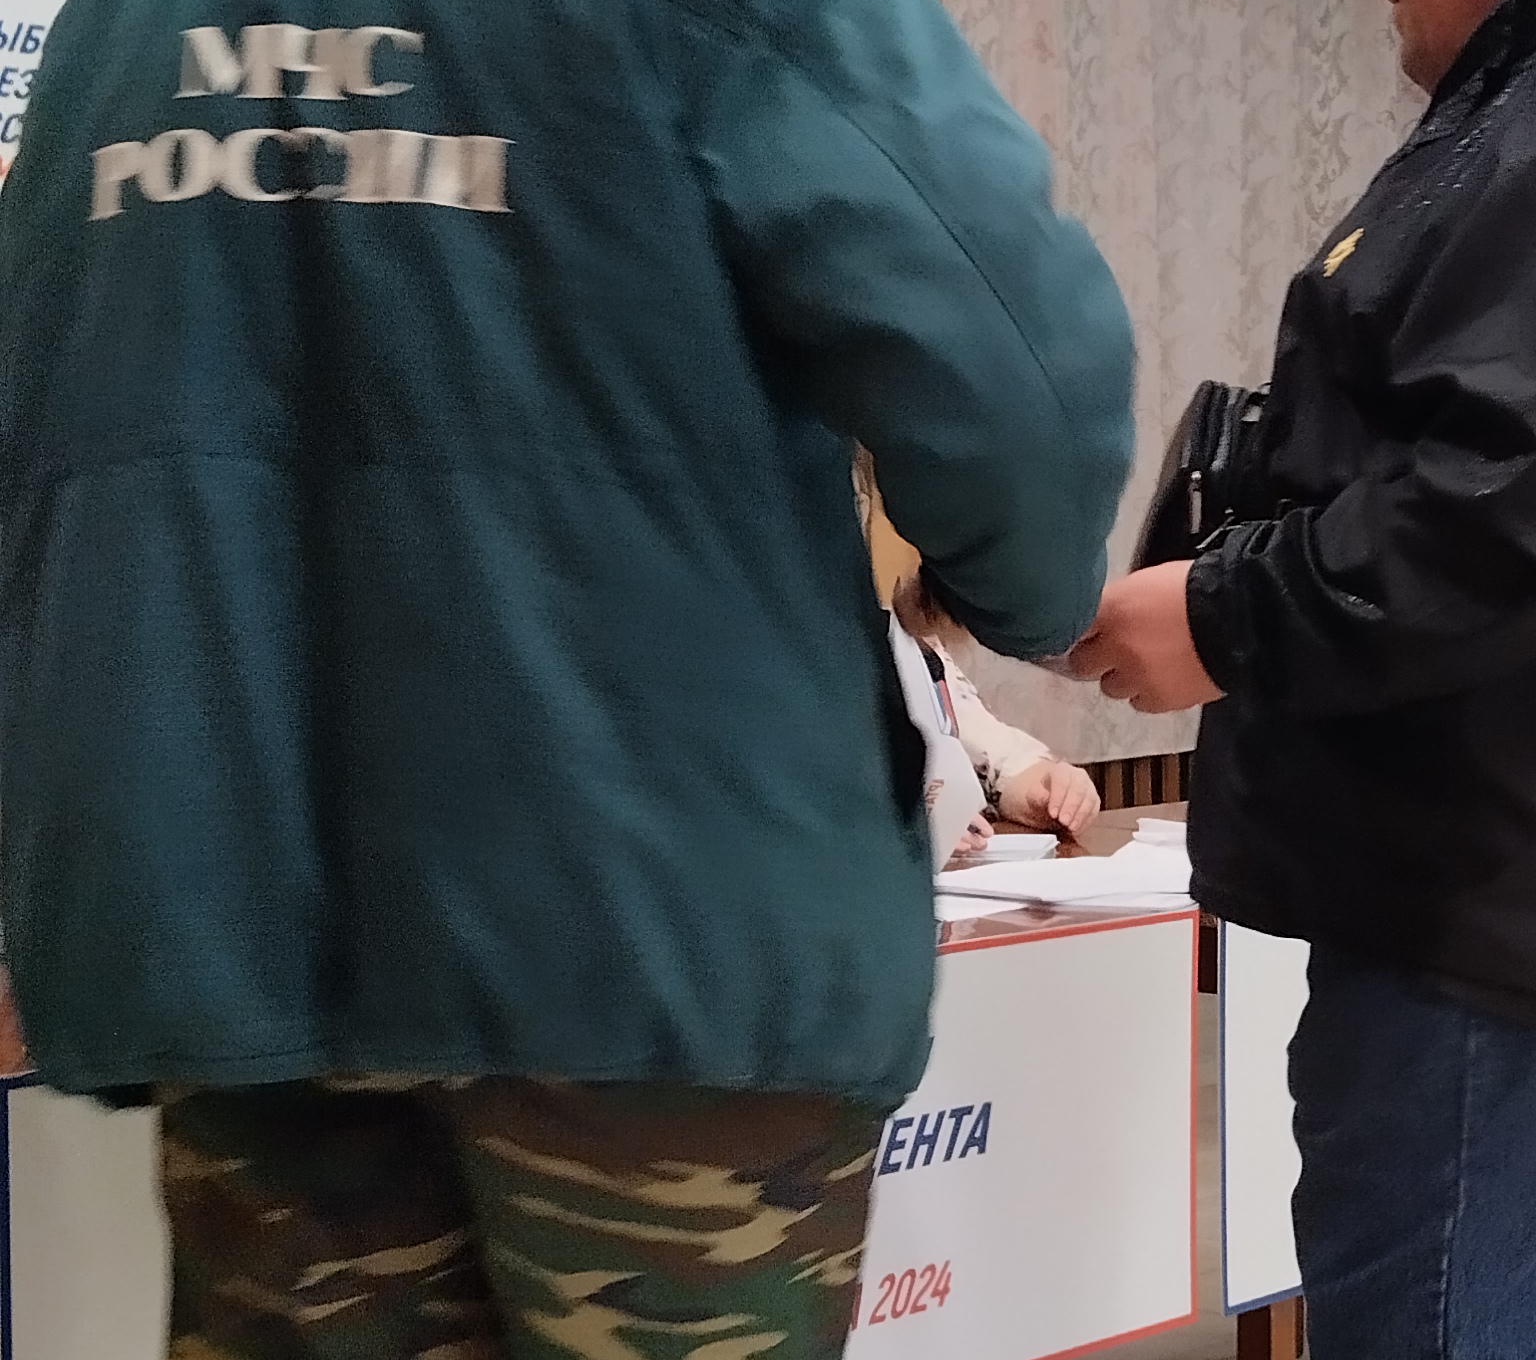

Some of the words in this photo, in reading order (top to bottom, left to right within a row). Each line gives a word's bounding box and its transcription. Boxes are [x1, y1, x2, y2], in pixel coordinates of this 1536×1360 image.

[174, 23, 424, 100] МЧС
[89, 127, 516, 221] РОССИИ
[878, 1101, 992, 1177] ЕНТА
[869, 1259, 952, 1327] 2024
